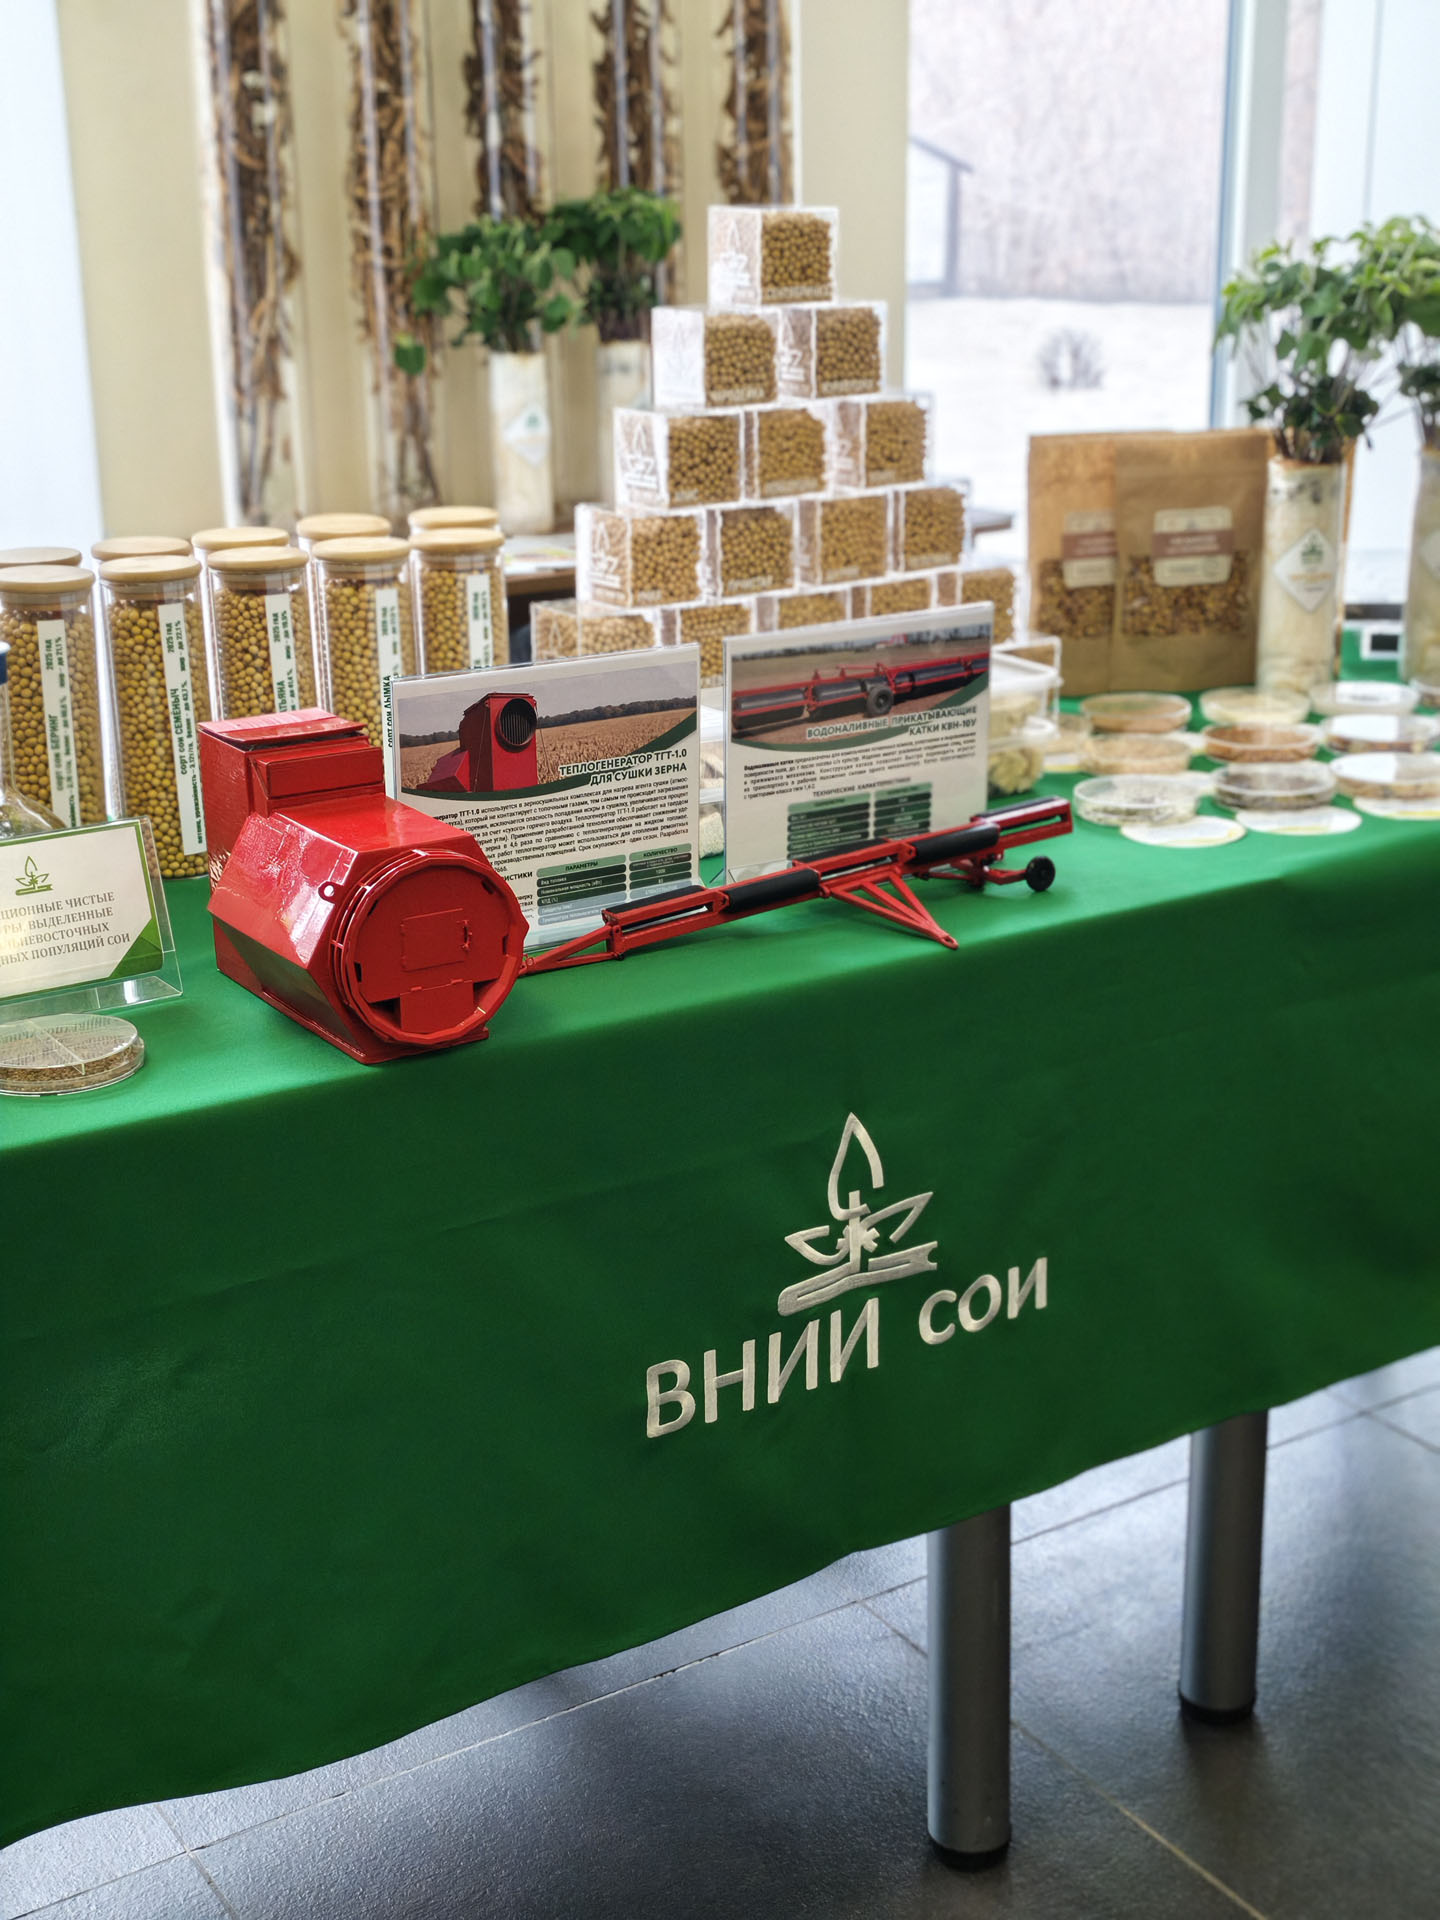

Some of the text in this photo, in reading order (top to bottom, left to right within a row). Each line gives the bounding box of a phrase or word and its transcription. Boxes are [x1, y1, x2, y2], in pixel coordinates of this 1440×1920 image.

[166, 636, 175, 652] 2025
[169, 688, 183, 734] СЕМЁНЫЧ
[807, 705, 977, 738] ВОДОНАЛИВНЫЕ ПРИКАТЫВАЮЩИЕ
[48, 714, 60, 749] БЕРИНГ
[909, 725, 939, 736] КАТКИ
[177, 736, 185, 752] сои
[179, 755, 188, 774] сорт
[559, 748, 687, 776] ТЕПЛОГЕНЕРАТОР ТГТ-1.0
[590, 761, 687, 786] ДЛЯ СУШКИ ЗЕРНА
[480, 803, 517, 814] используется
[613, 785, 633, 794] нагрева
[464, 815, 487, 824] который
[496, 808, 532, 819] контактирует
[538, 803, 567, 812] топочными
[465, 823, 488, 832] горения,
[525, 813, 553, 821] опасность
[574, 810, 615, 822] Теплогенератор
[497, 849, 512, 858] работ
[515, 843, 556, 855] теплогенератор
[578, 844, 591, 852] Срок
[504, 871, 533, 881] ИСТИКИ
[565, 861, 598, 871] ПАРАМЕТРЫ
[0, 891, 115, 920] ЦИОННЫЕ ЧИСТЫЕ
[28, 906, 114, 930] ВЫДЕЛЕННЫЕ
[0, 932, 131, 967] НЫХ ПОПУЛЯЦИЙ СОИ
[646, 1297, 879, 1438] ВНИИ
